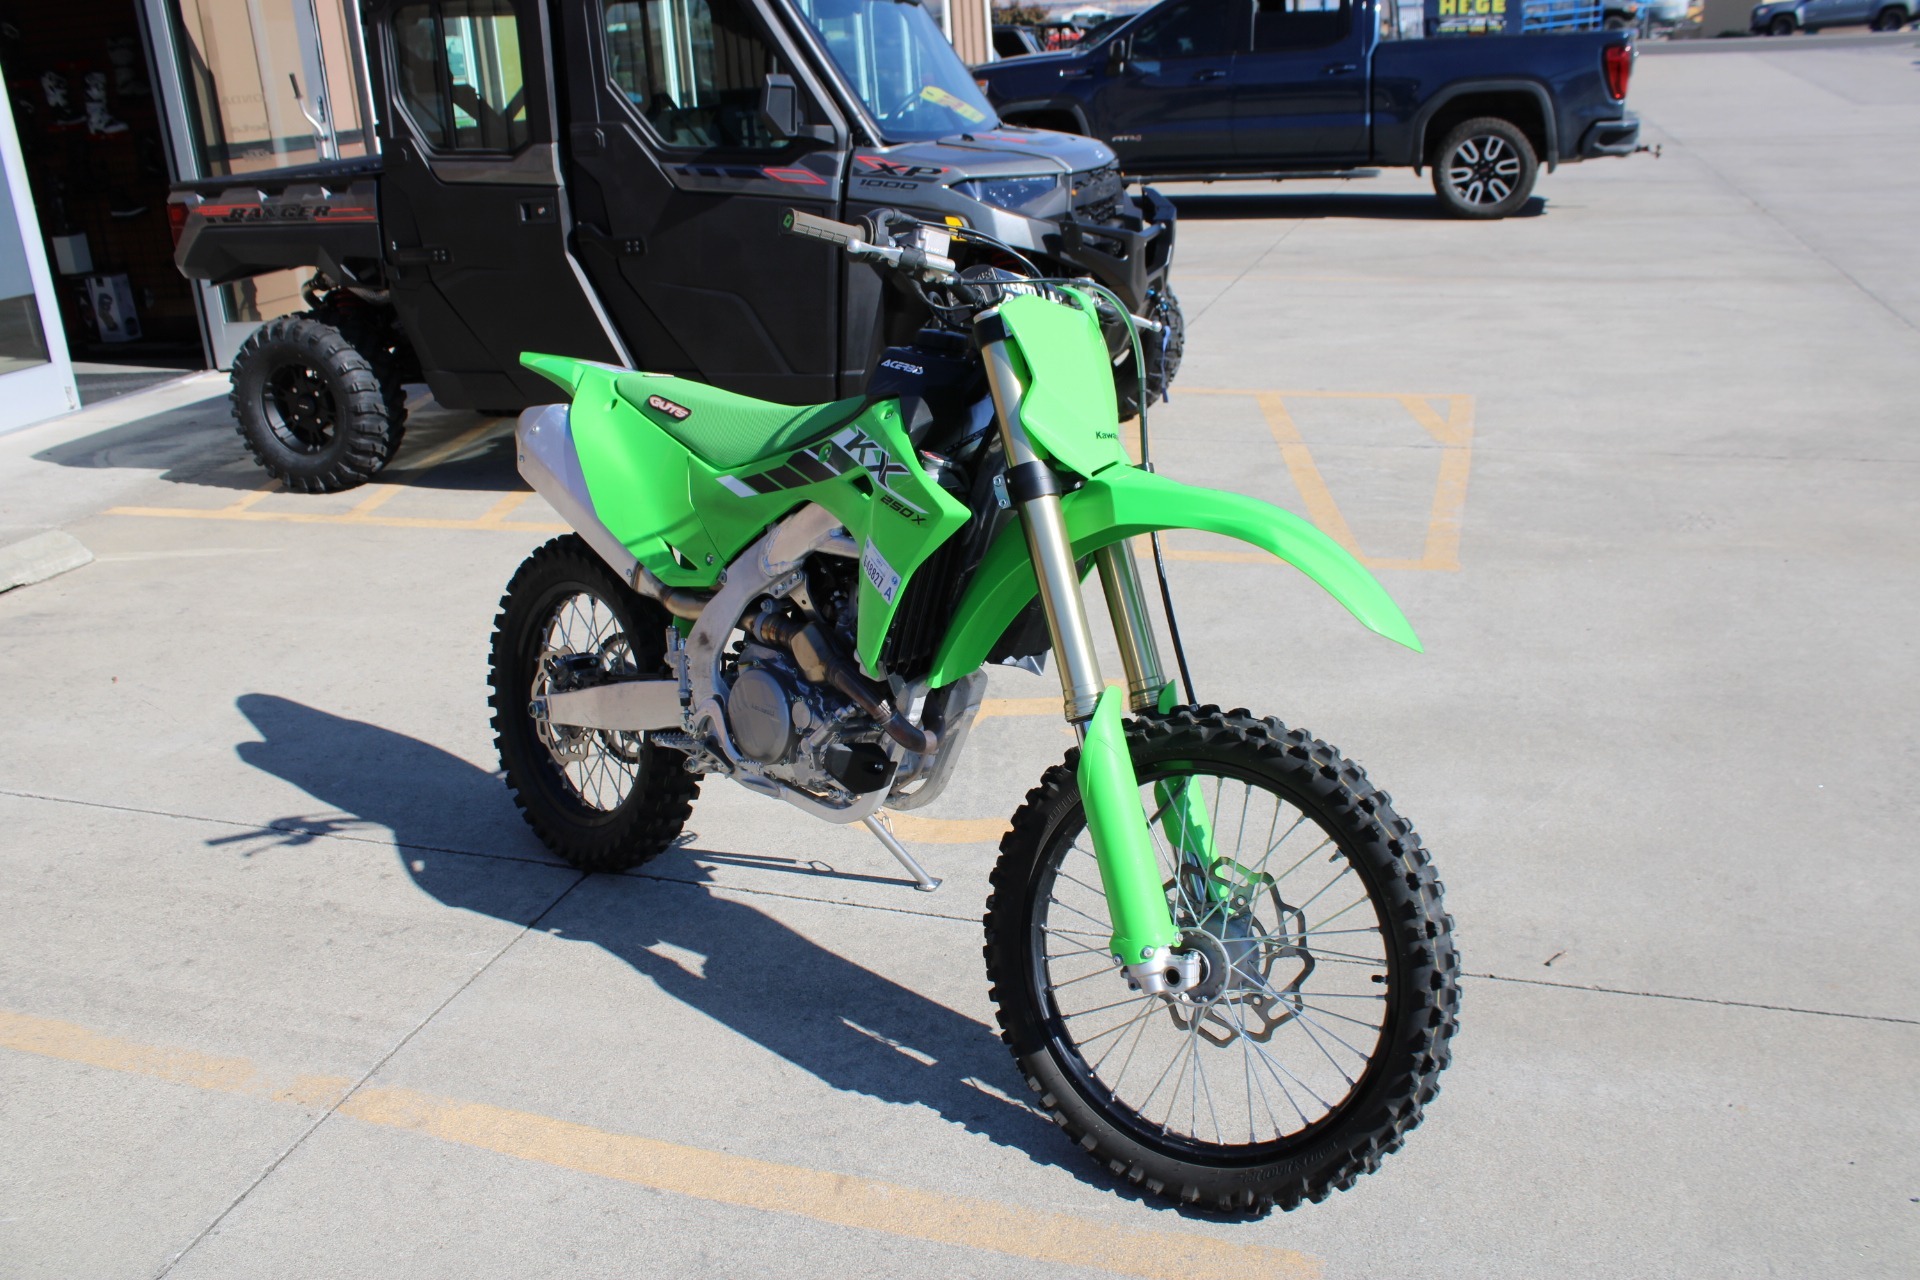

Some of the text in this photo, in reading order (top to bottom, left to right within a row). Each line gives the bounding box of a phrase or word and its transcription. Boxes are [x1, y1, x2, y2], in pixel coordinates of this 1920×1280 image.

[866, 162, 943, 177] XP
[860, 179, 919, 190] 1000
[229, 204, 332, 220] RANGER
[649, 395, 690, 418] GUTS
[843, 424, 910, 489] KX
[884, 586, 892, 602] A
